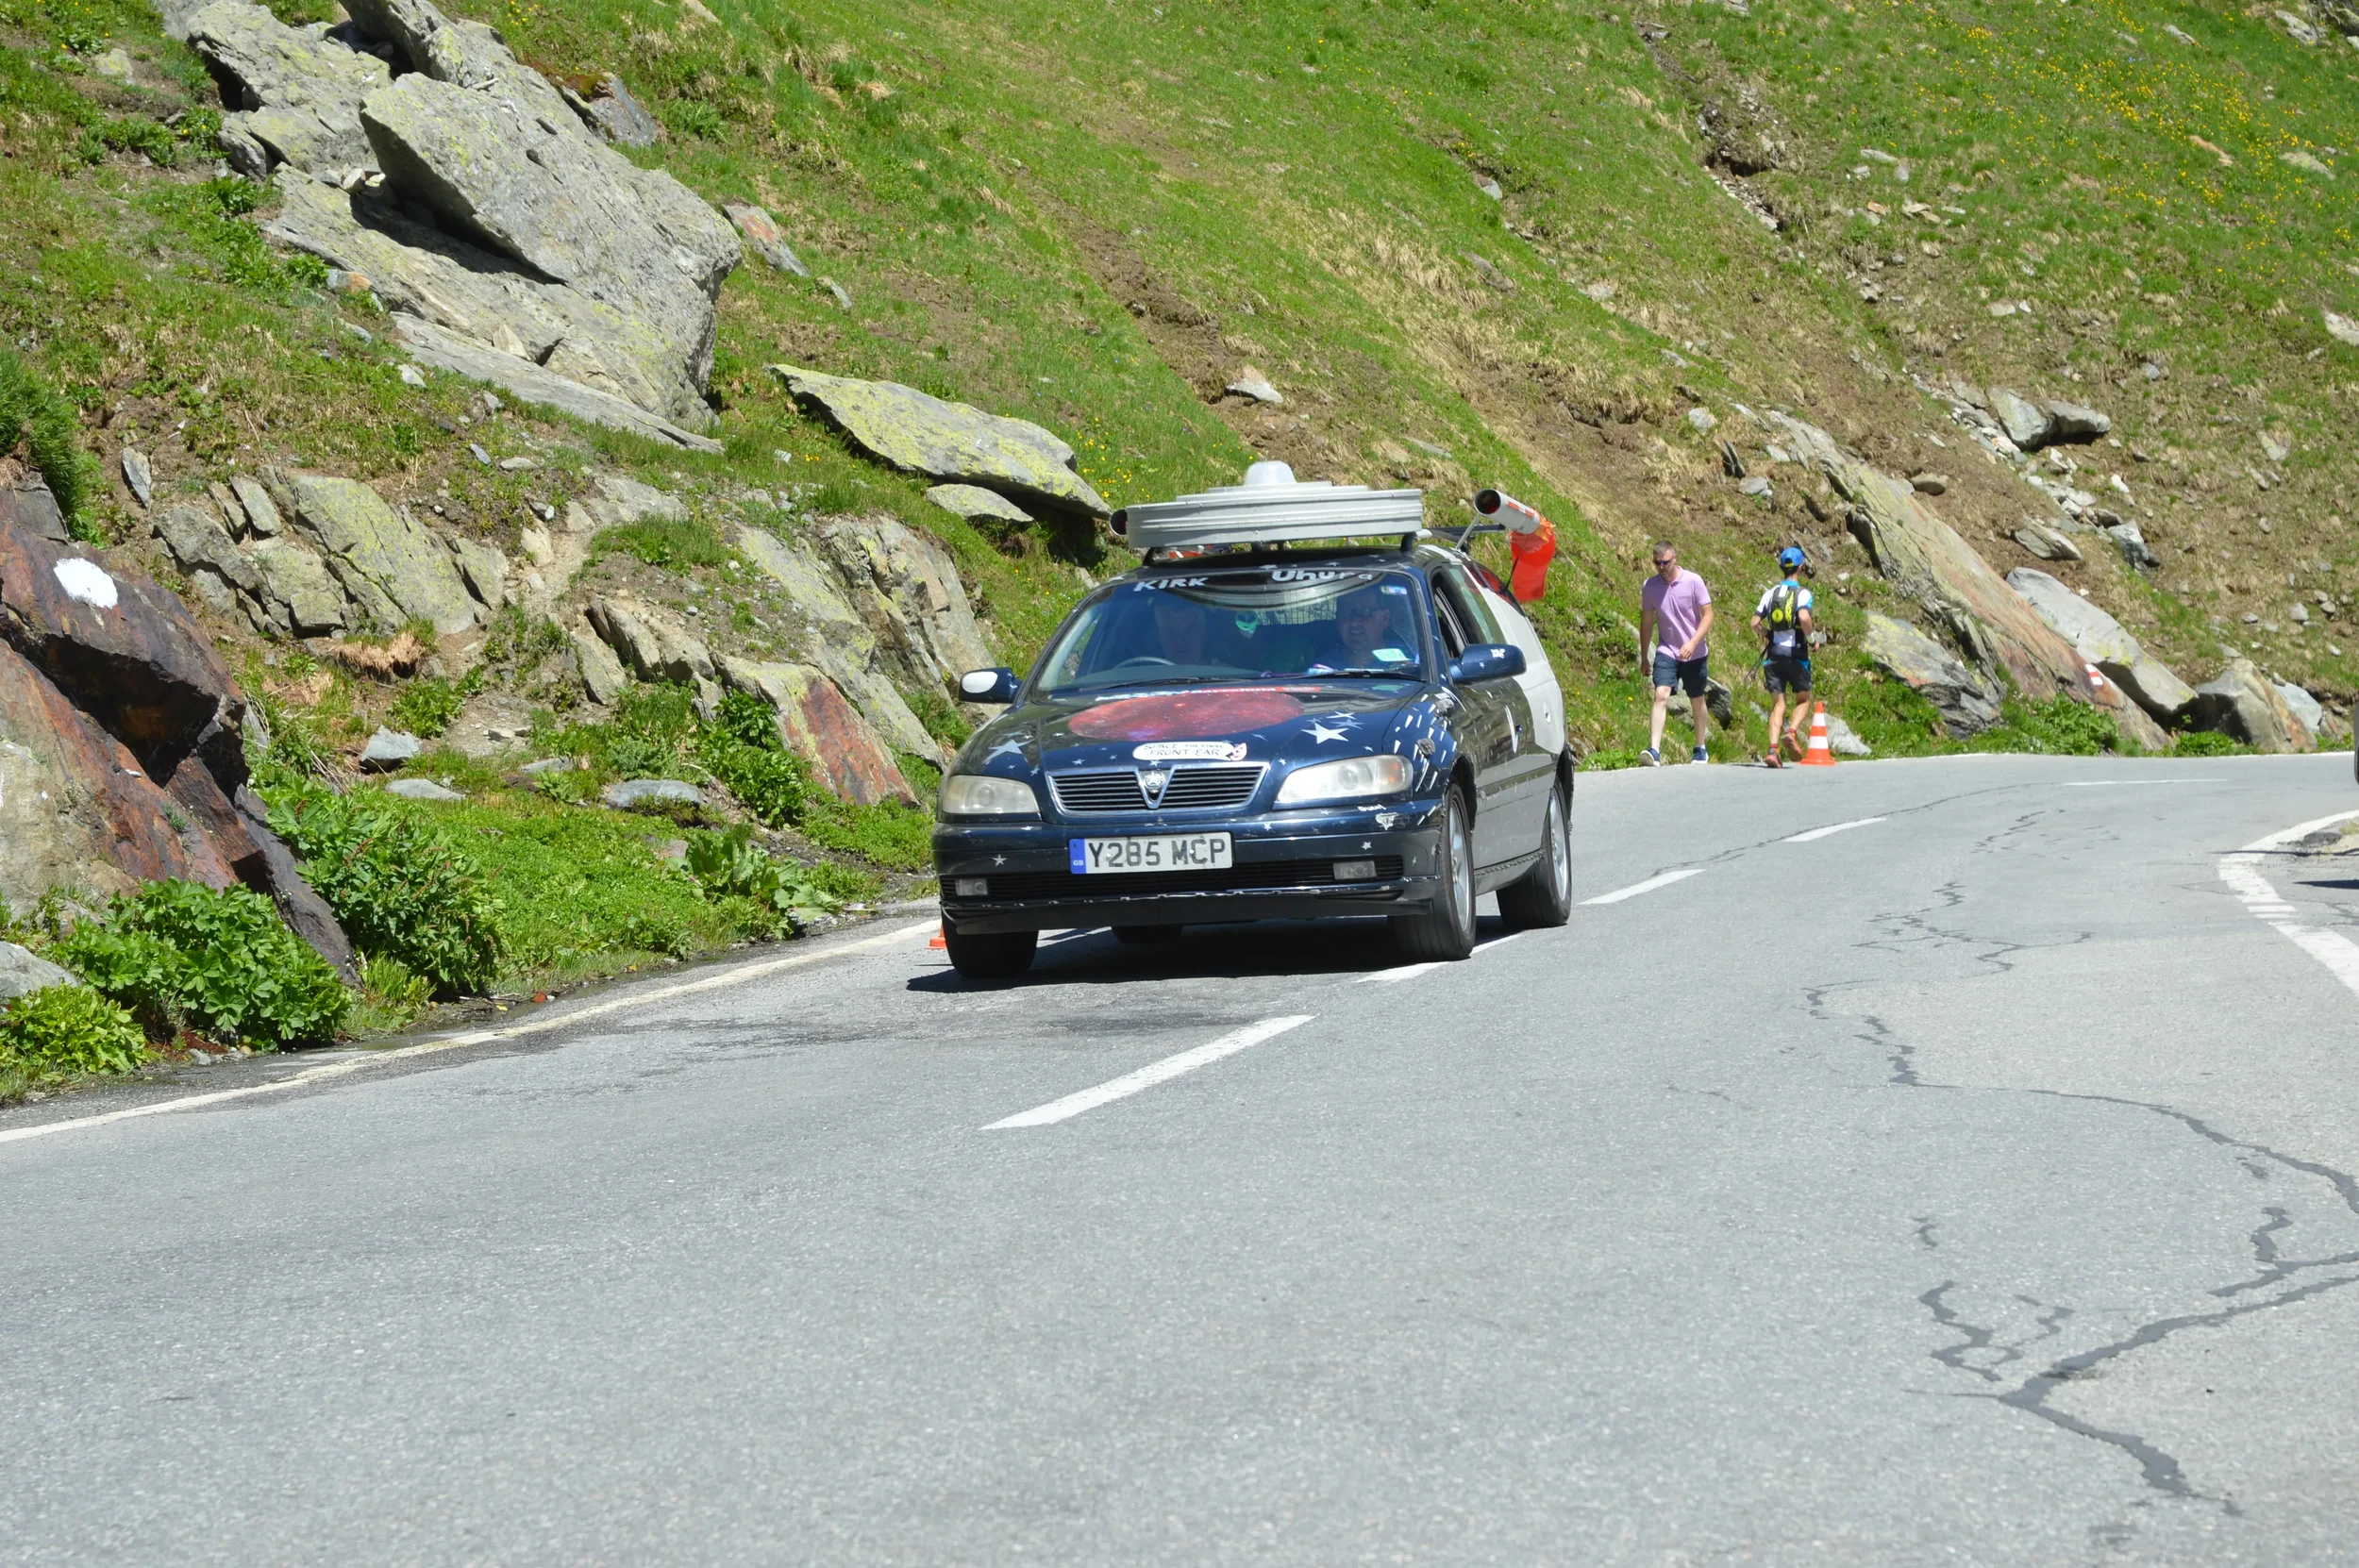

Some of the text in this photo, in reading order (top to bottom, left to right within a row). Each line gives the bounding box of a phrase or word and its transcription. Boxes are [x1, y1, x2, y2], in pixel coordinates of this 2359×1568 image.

[1271, 570, 1375, 582] Uhura
[1133, 577, 1209, 592] KIRK
[1088, 838, 1226, 868] Y285 MCP
